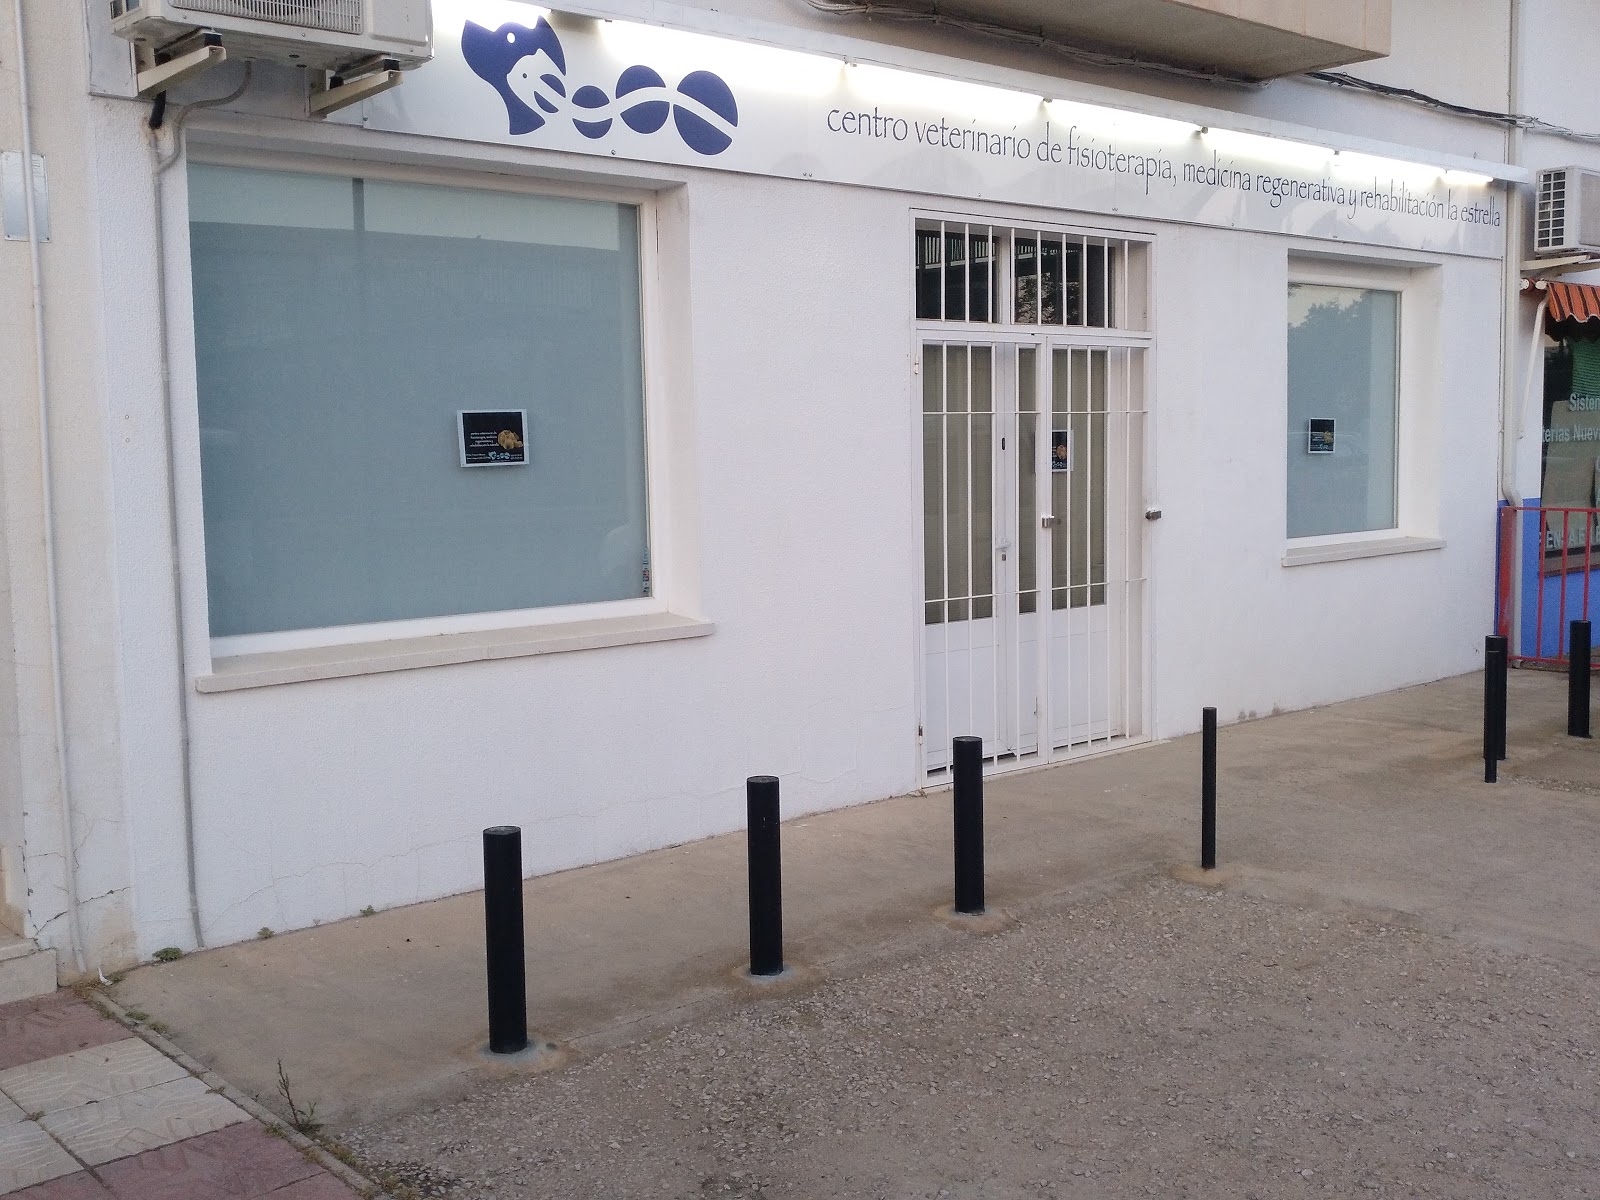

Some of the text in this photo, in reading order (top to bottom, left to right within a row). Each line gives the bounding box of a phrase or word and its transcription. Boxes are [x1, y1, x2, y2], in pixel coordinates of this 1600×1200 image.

[827, 106, 1501, 227] centro veterinario de fisioterapia, medicina regenerativa y rehabilitación la estrella
[1573, 424, 1600, 442] Nuev
